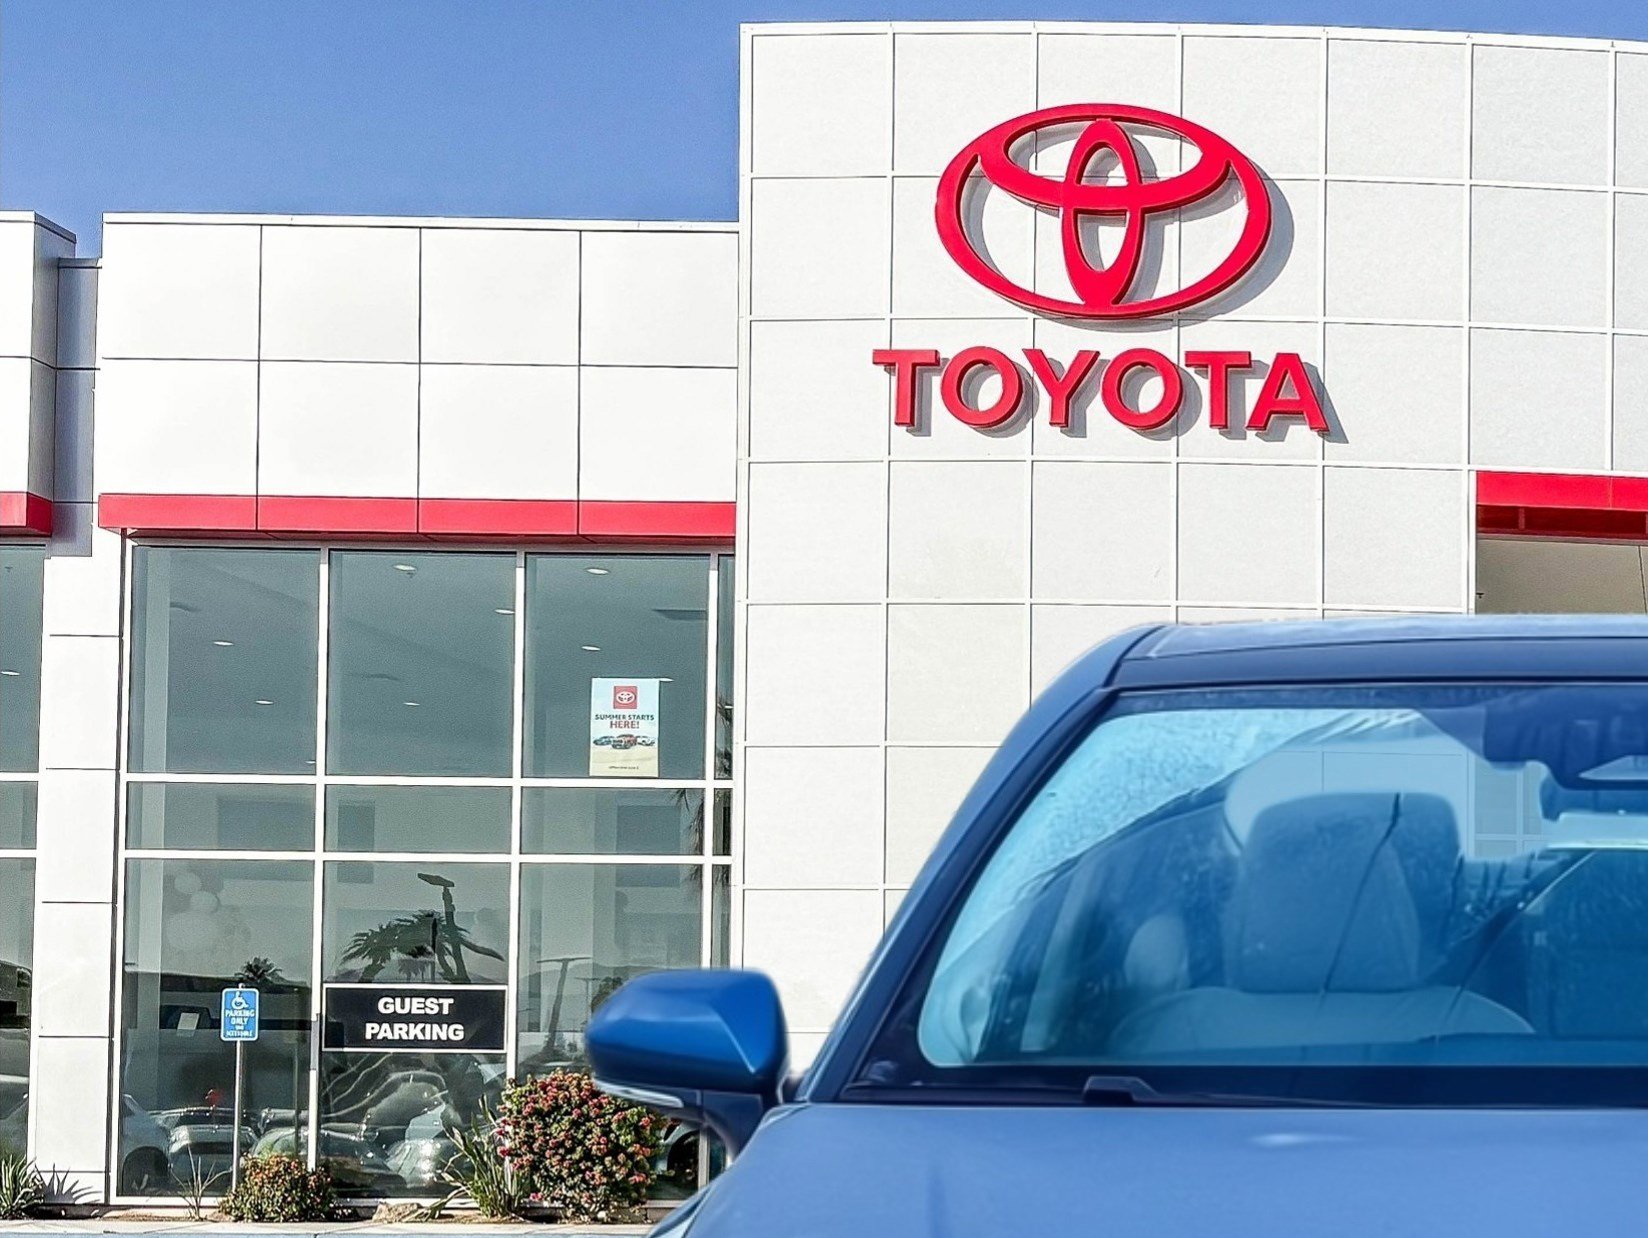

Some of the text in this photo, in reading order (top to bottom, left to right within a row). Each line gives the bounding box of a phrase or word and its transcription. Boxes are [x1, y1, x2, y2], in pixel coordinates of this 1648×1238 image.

[872, 346, 1329, 432] TOYOTA
[609, 720, 640, 729] HERE!
[377, 996, 455, 1015] GUEST
[365, 1022, 465, 1041] PARKING
